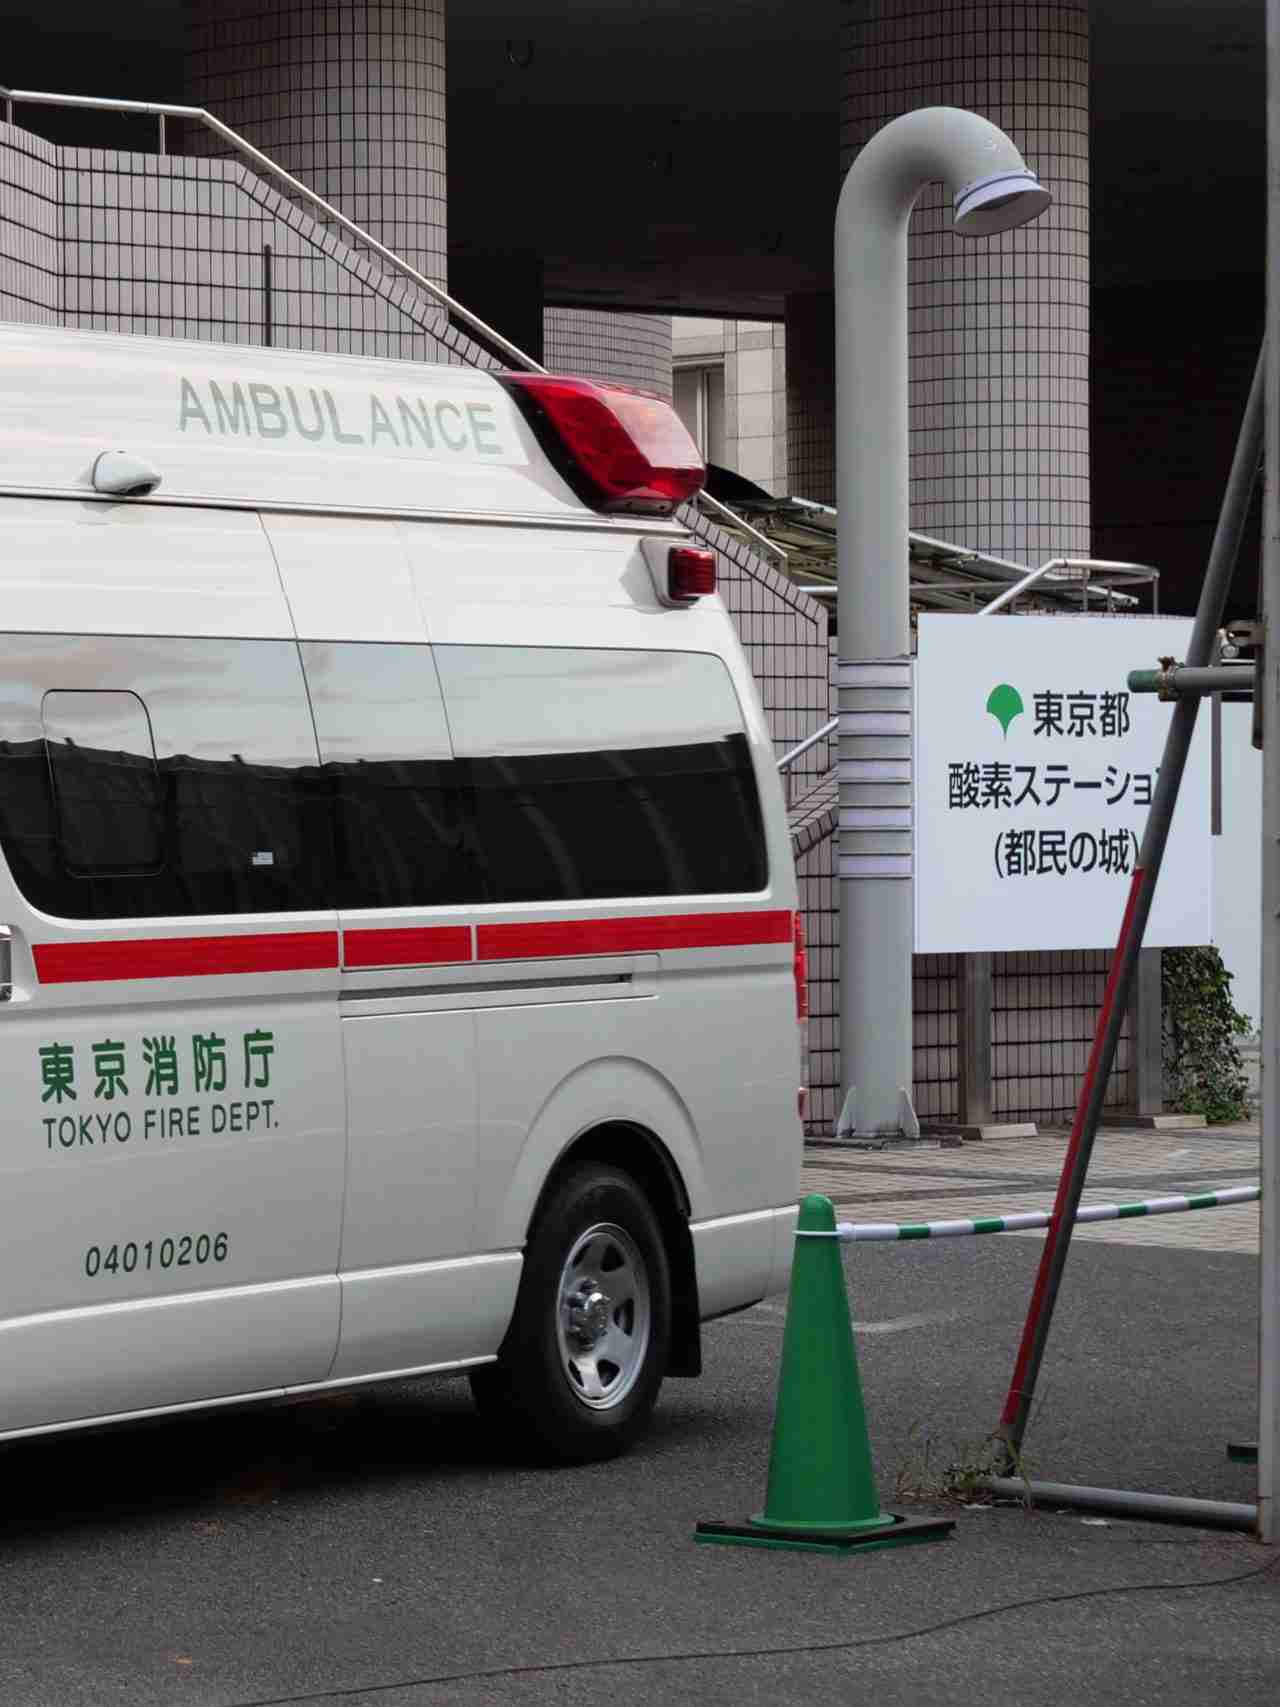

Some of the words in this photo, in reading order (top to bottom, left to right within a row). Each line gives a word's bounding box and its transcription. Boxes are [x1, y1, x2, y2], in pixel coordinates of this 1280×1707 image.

[177, 376, 503, 454] AMBULANCE
[1033, 690, 1130, 737] 東京都
[948, 761, 1159, 809] 酸素ステーショ
[994, 828, 1140, 878] (都民の城)
[39, 1029, 274, 1104] 東京消防庁
[42, 1111, 132, 1148] TOKYO
[144, 1106, 200, 1139] FIRE
[211, 1099, 279, 1134] DEPT.
[85, 1232, 228, 1277] 04010206
